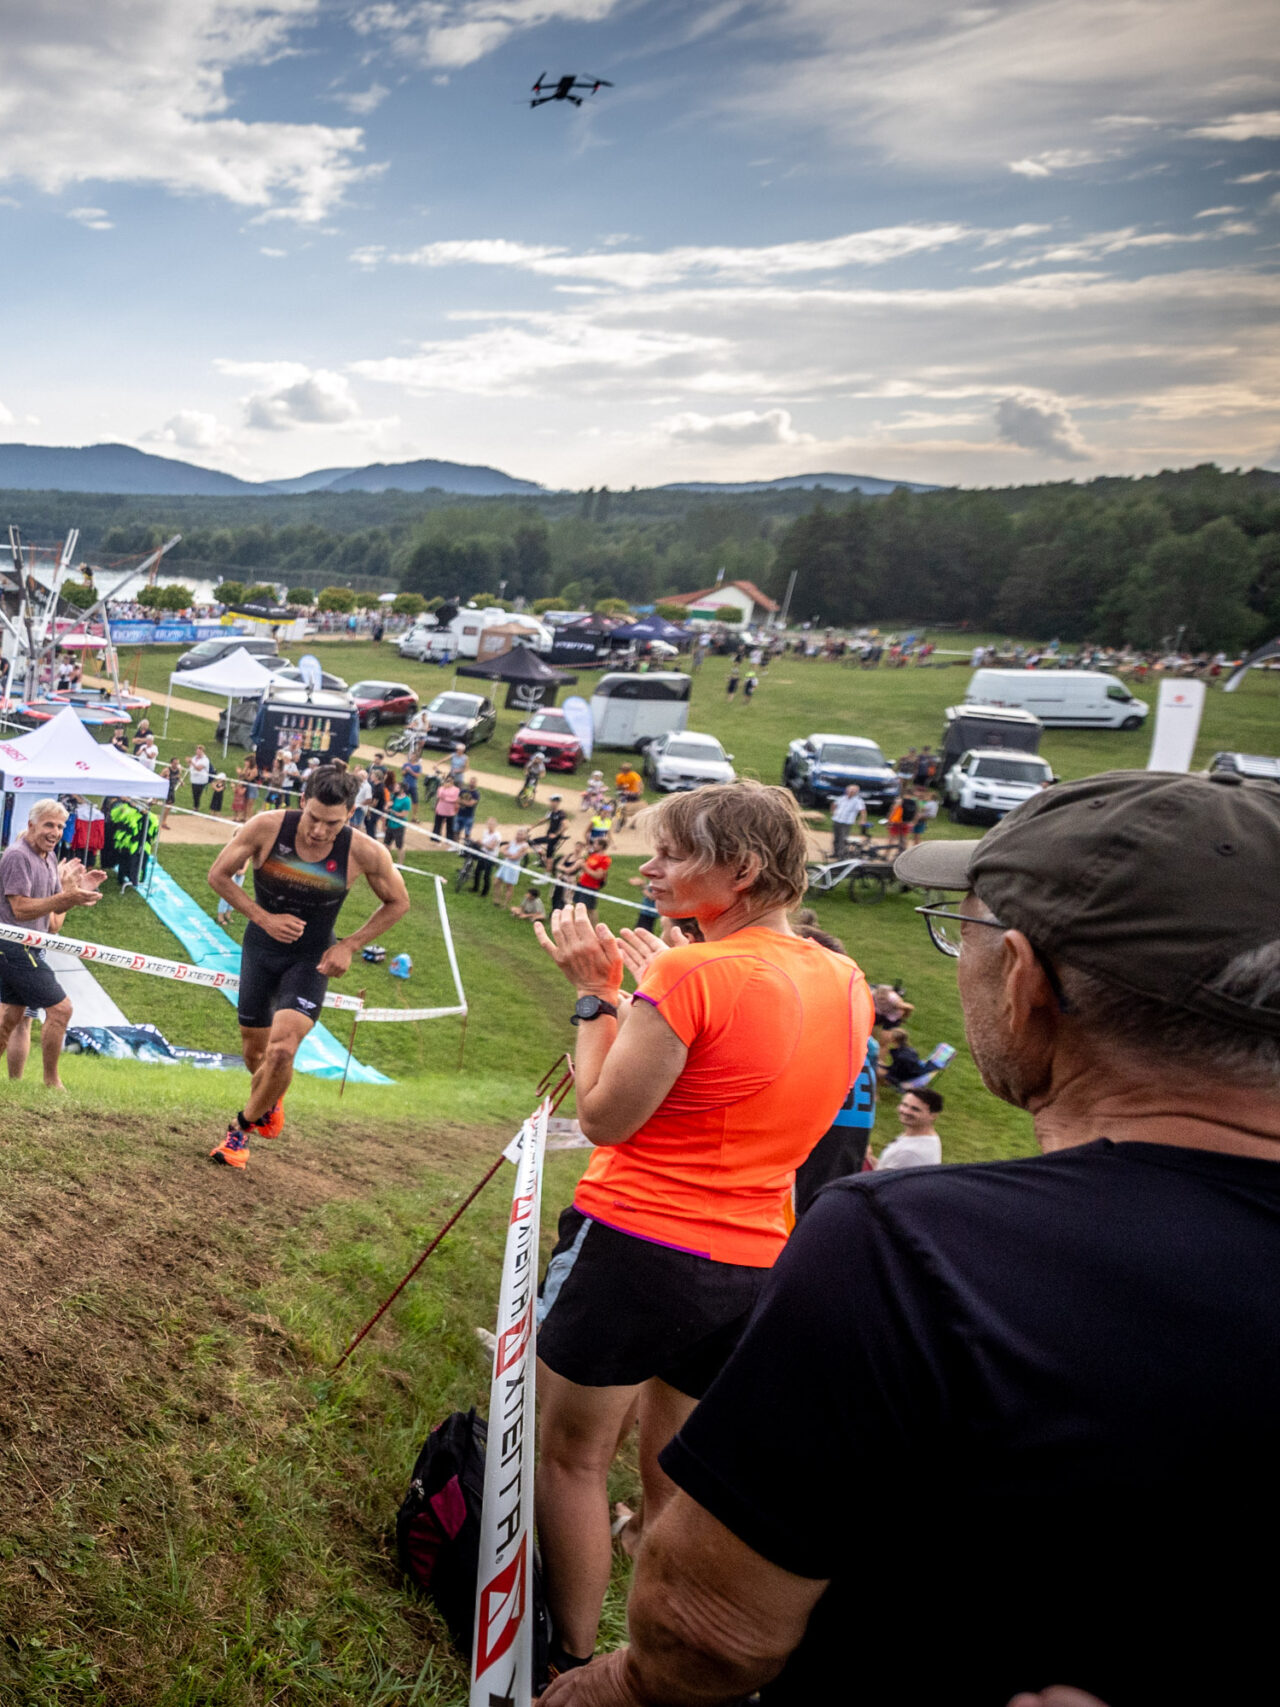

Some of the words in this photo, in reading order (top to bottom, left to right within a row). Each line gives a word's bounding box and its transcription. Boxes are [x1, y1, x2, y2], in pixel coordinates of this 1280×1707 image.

[43, 939, 83, 954] XTERRA
[98, 951, 133, 965] XTERRA
[145, 962, 177, 974] XTERRA
